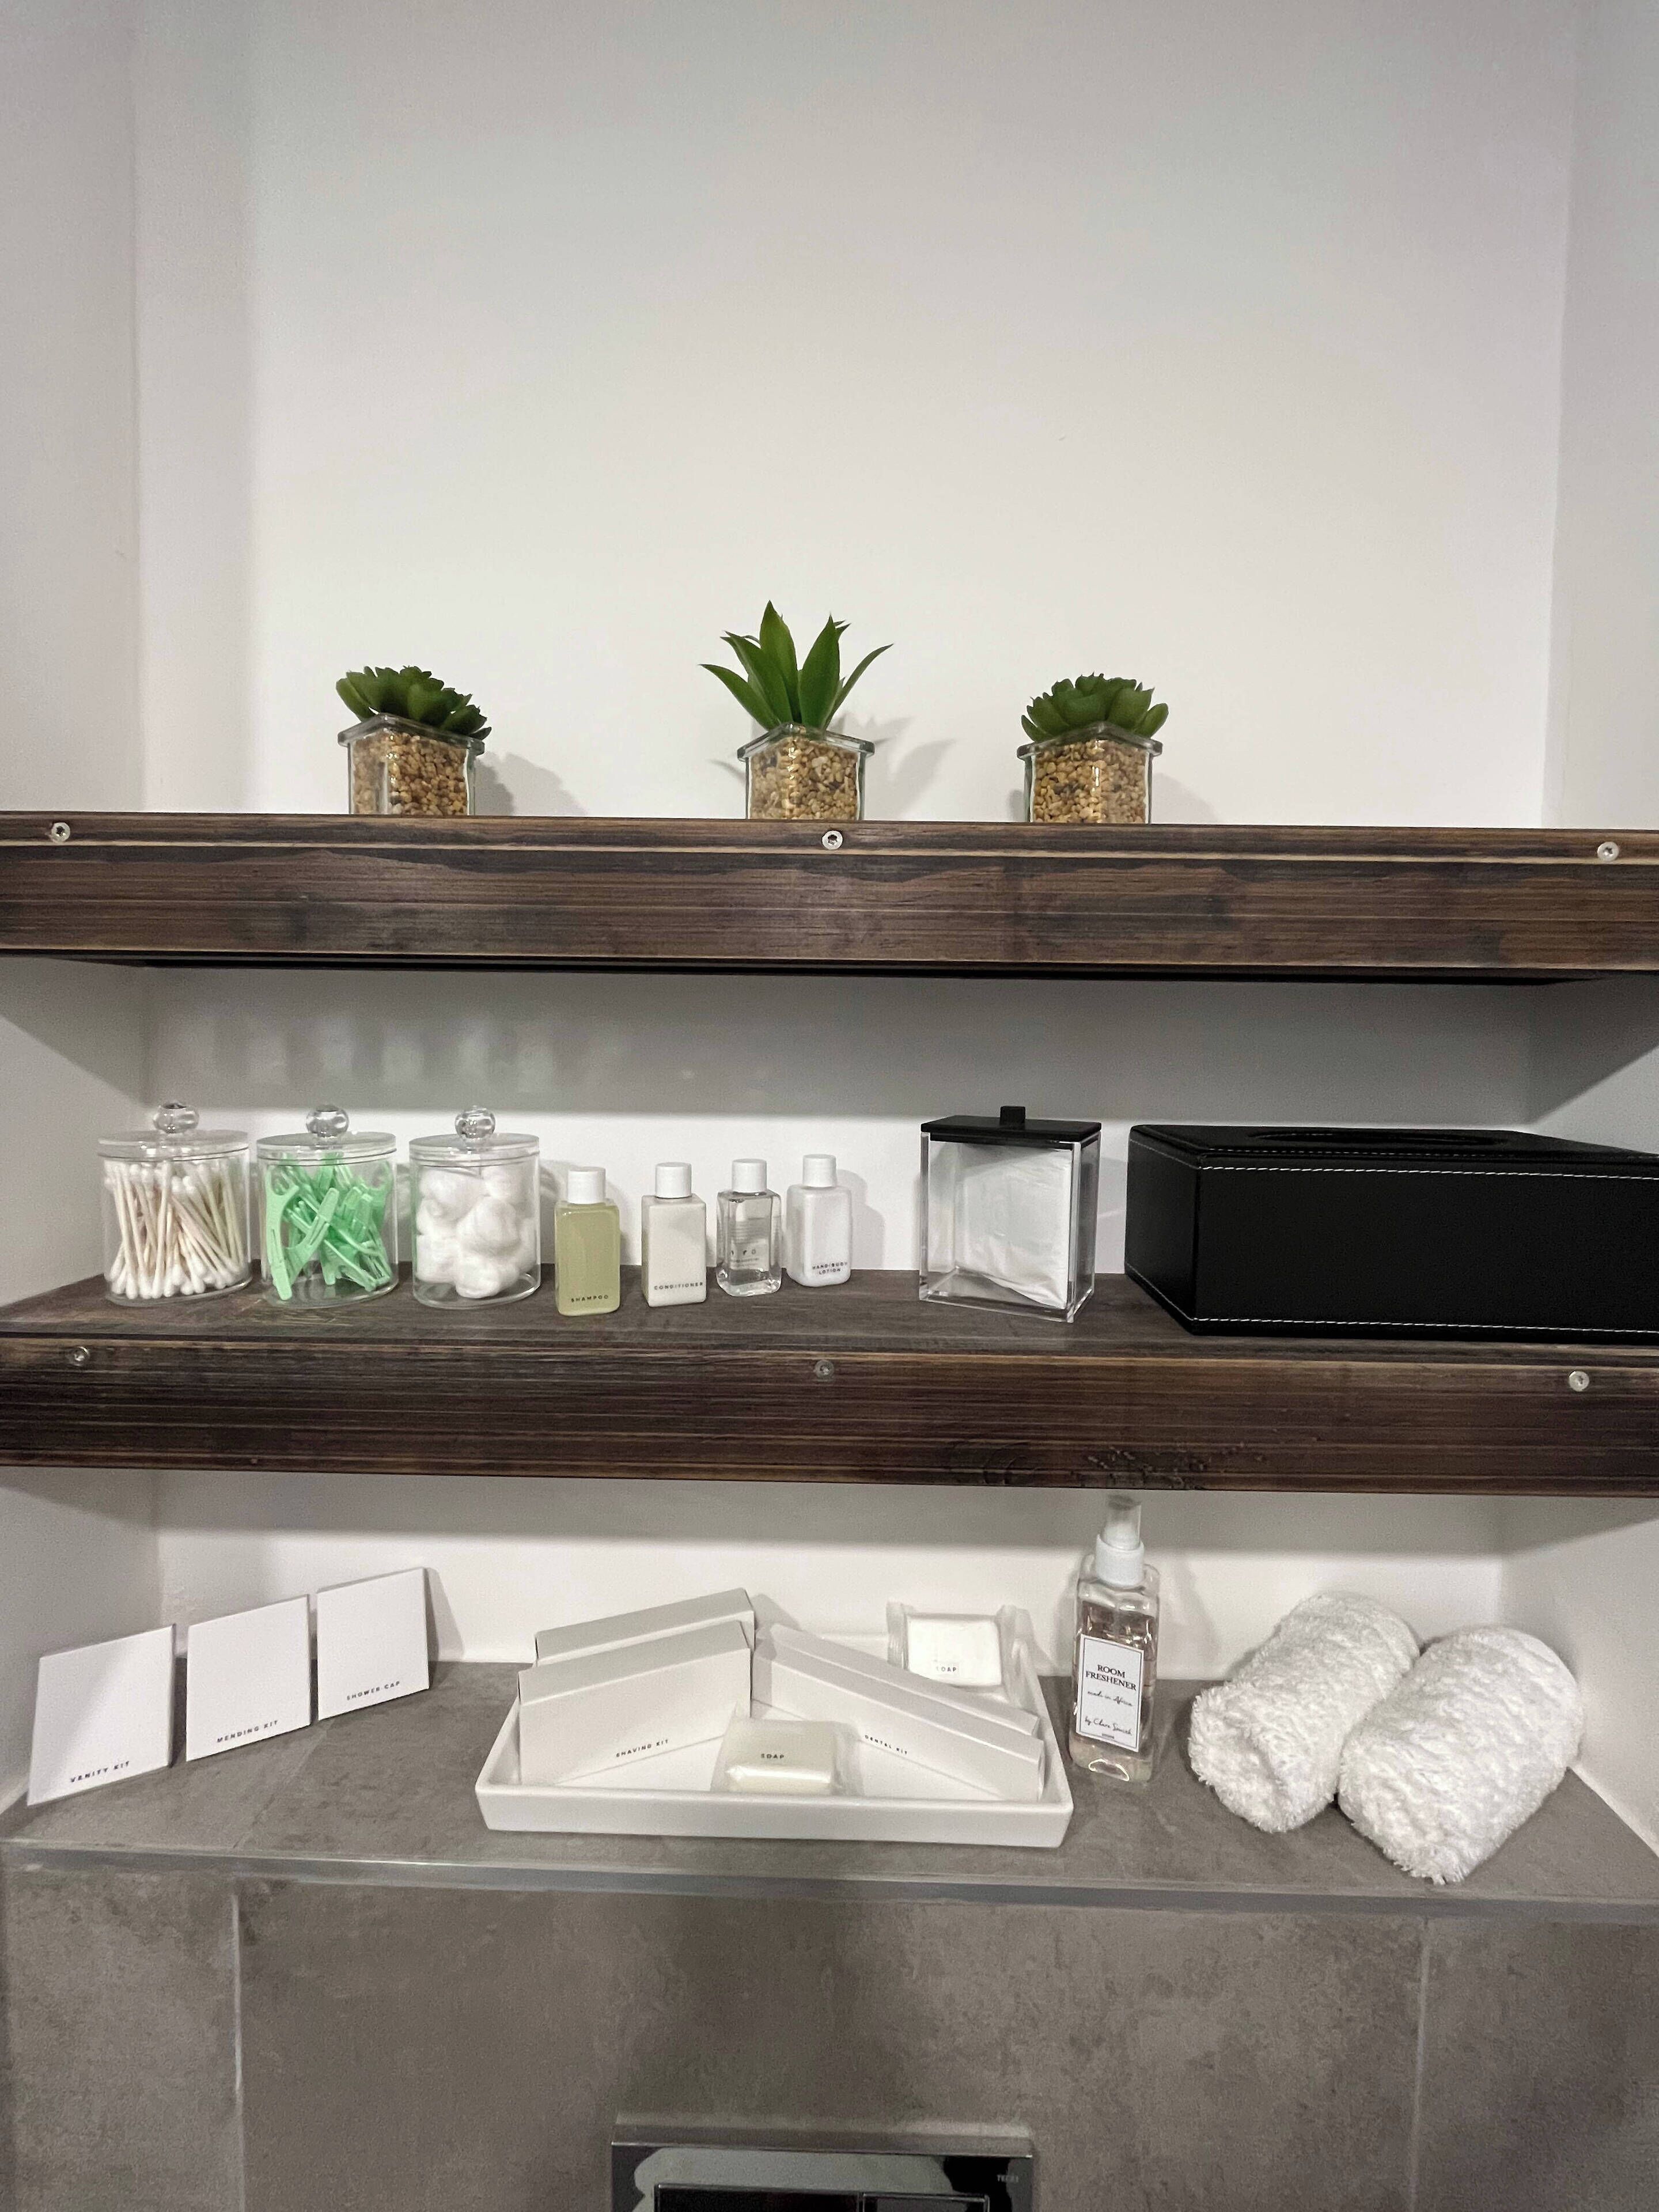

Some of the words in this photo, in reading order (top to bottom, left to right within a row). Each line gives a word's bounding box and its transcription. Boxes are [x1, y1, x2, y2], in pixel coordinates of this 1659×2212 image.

[654, 1282, 703, 1290] CONDITIONER
[571, 1294, 609, 1302] SHAMPOO
[1097, 1664, 1126, 1678] ROOM
[1085, 1671, 1137, 1691] FRESHENER
[347, 1687, 380, 1700] SHOWER
[384, 1681, 400, 1689] CAP
[1085, 1716, 1091, 1726] by
[217, 1726, 259, 1743] MENDING
[264, 1720, 278, 1729] KIT
[616, 1744, 652, 1758] SHAVING
[70, 1767, 108, 1783] VANITY
[113, 1761, 130, 1770] KIT
